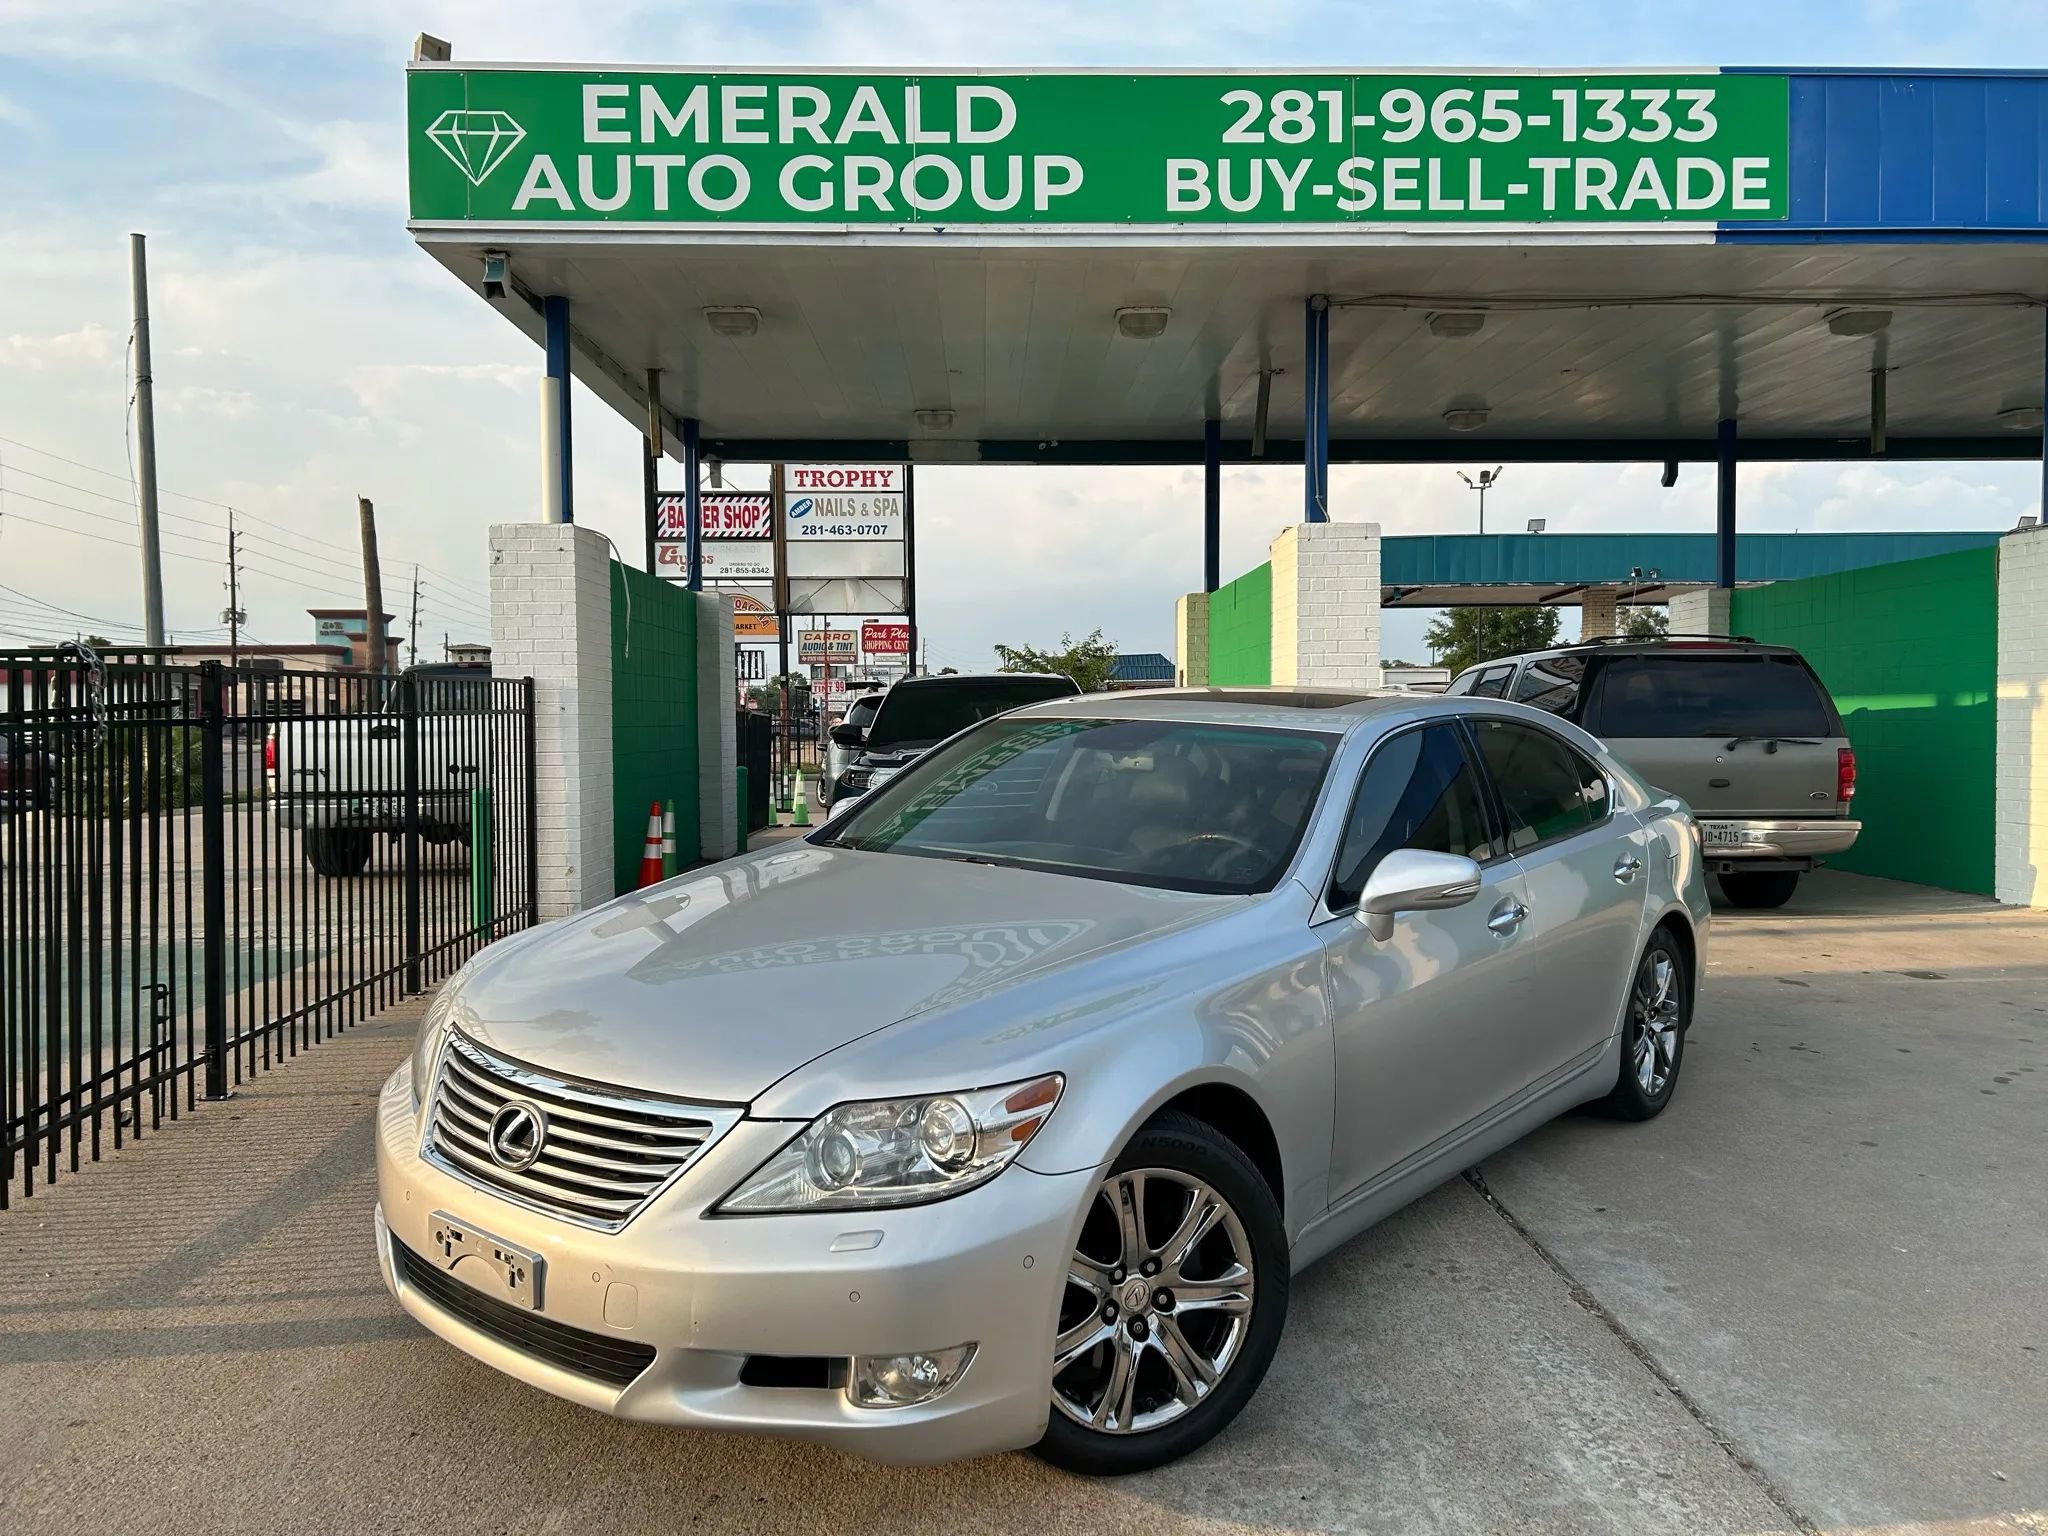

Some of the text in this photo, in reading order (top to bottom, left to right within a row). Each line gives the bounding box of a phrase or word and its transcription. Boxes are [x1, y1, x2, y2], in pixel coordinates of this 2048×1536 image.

[581, 84, 1017, 145] EMERALD
[1219, 88, 1719, 144] 281-965-1333
[511, 153, 1084, 213] AUTO GROUP
[1165, 156, 1771, 213] BUY-SELL-TRADE
[794, 469, 894, 488] TROPHY
[790, 499, 813, 518] AMBER
[814, 497, 900, 517] NAILS & SPA
[667, 505, 761, 529] BAER SHOP
[801, 524, 888, 536] 281-463-0707
[658, 545, 714, 573] Gyos
[719, 566, 770, 574] 281-855-8342
[804, 633, 851, 641] CARRO
[864, 627, 888, 639] Park
[801, 642, 854, 652] AUDIO & TINT
[864, 640, 910, 650] SHOPPING CENT
